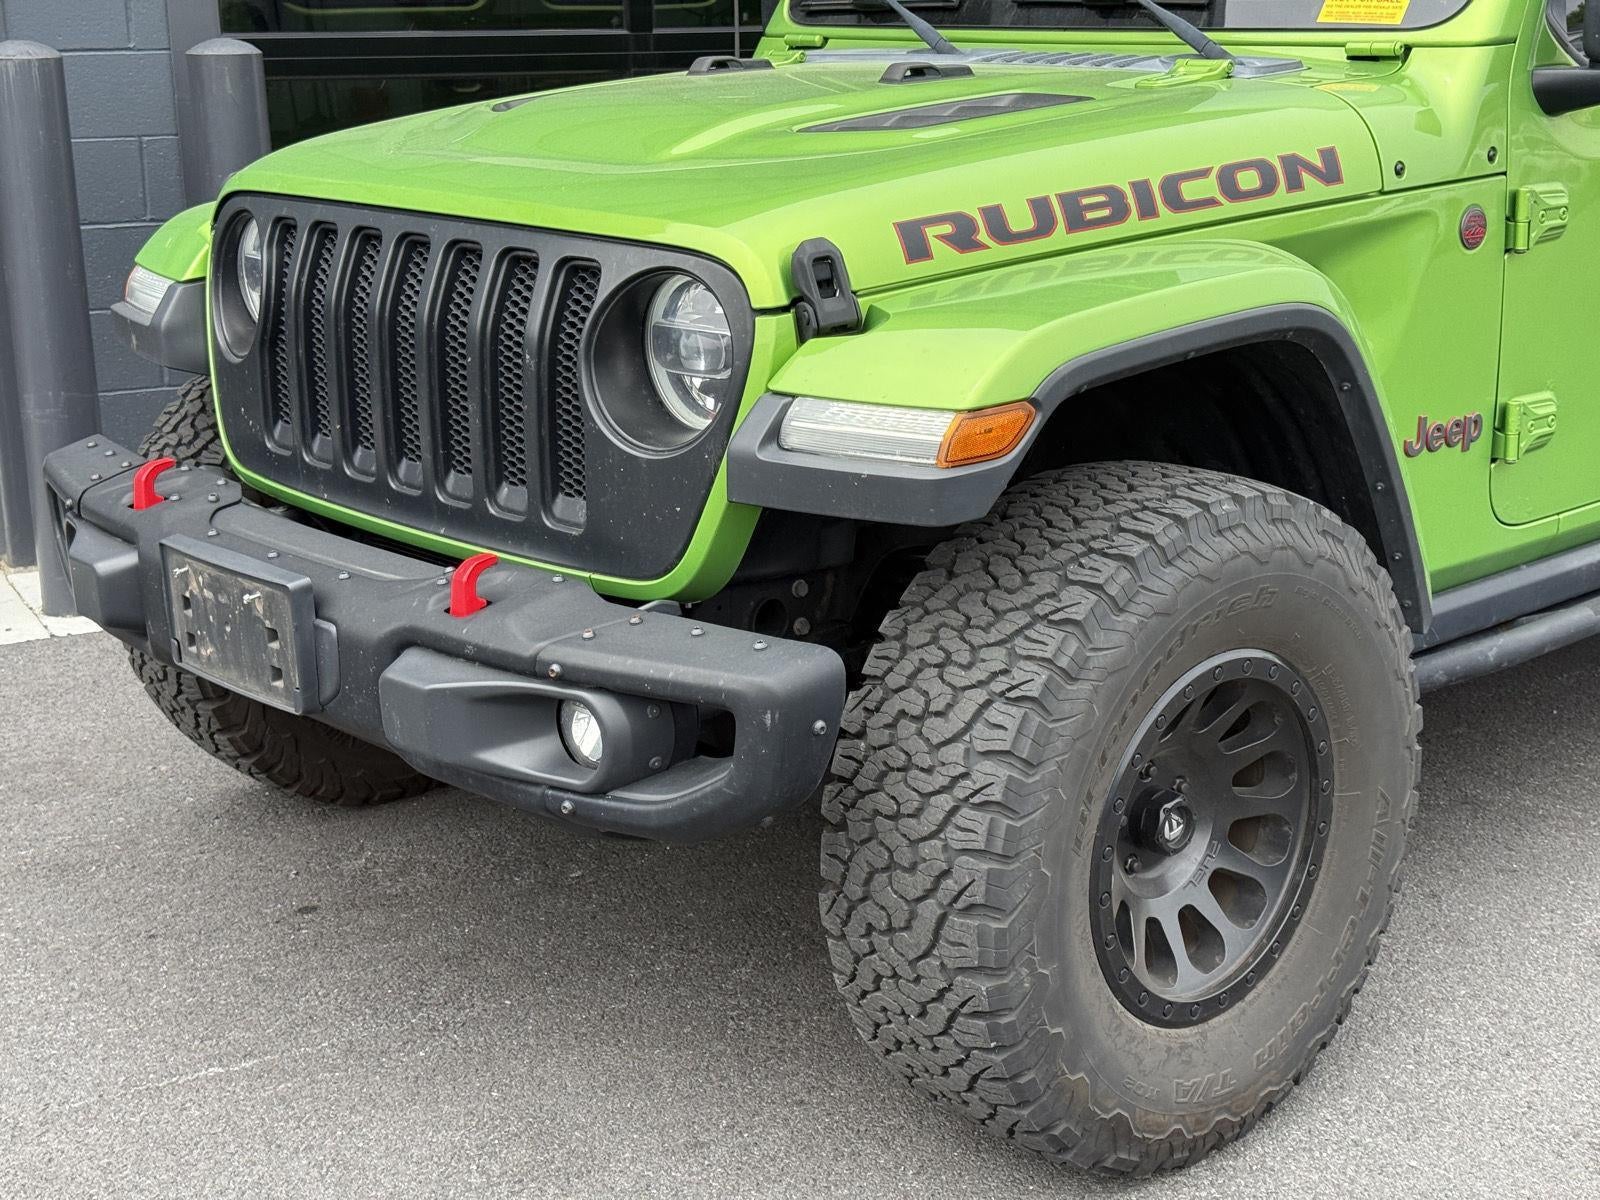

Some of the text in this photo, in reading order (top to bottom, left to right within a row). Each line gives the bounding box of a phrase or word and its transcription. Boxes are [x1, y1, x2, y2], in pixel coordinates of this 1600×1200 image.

[893, 145, 1344, 265] RUBICON
[1404, 412, 1483, 458] Jeep
[1182, 840, 1222, 890] FUEL
[1173, 1067, 1237, 1104] T/A
